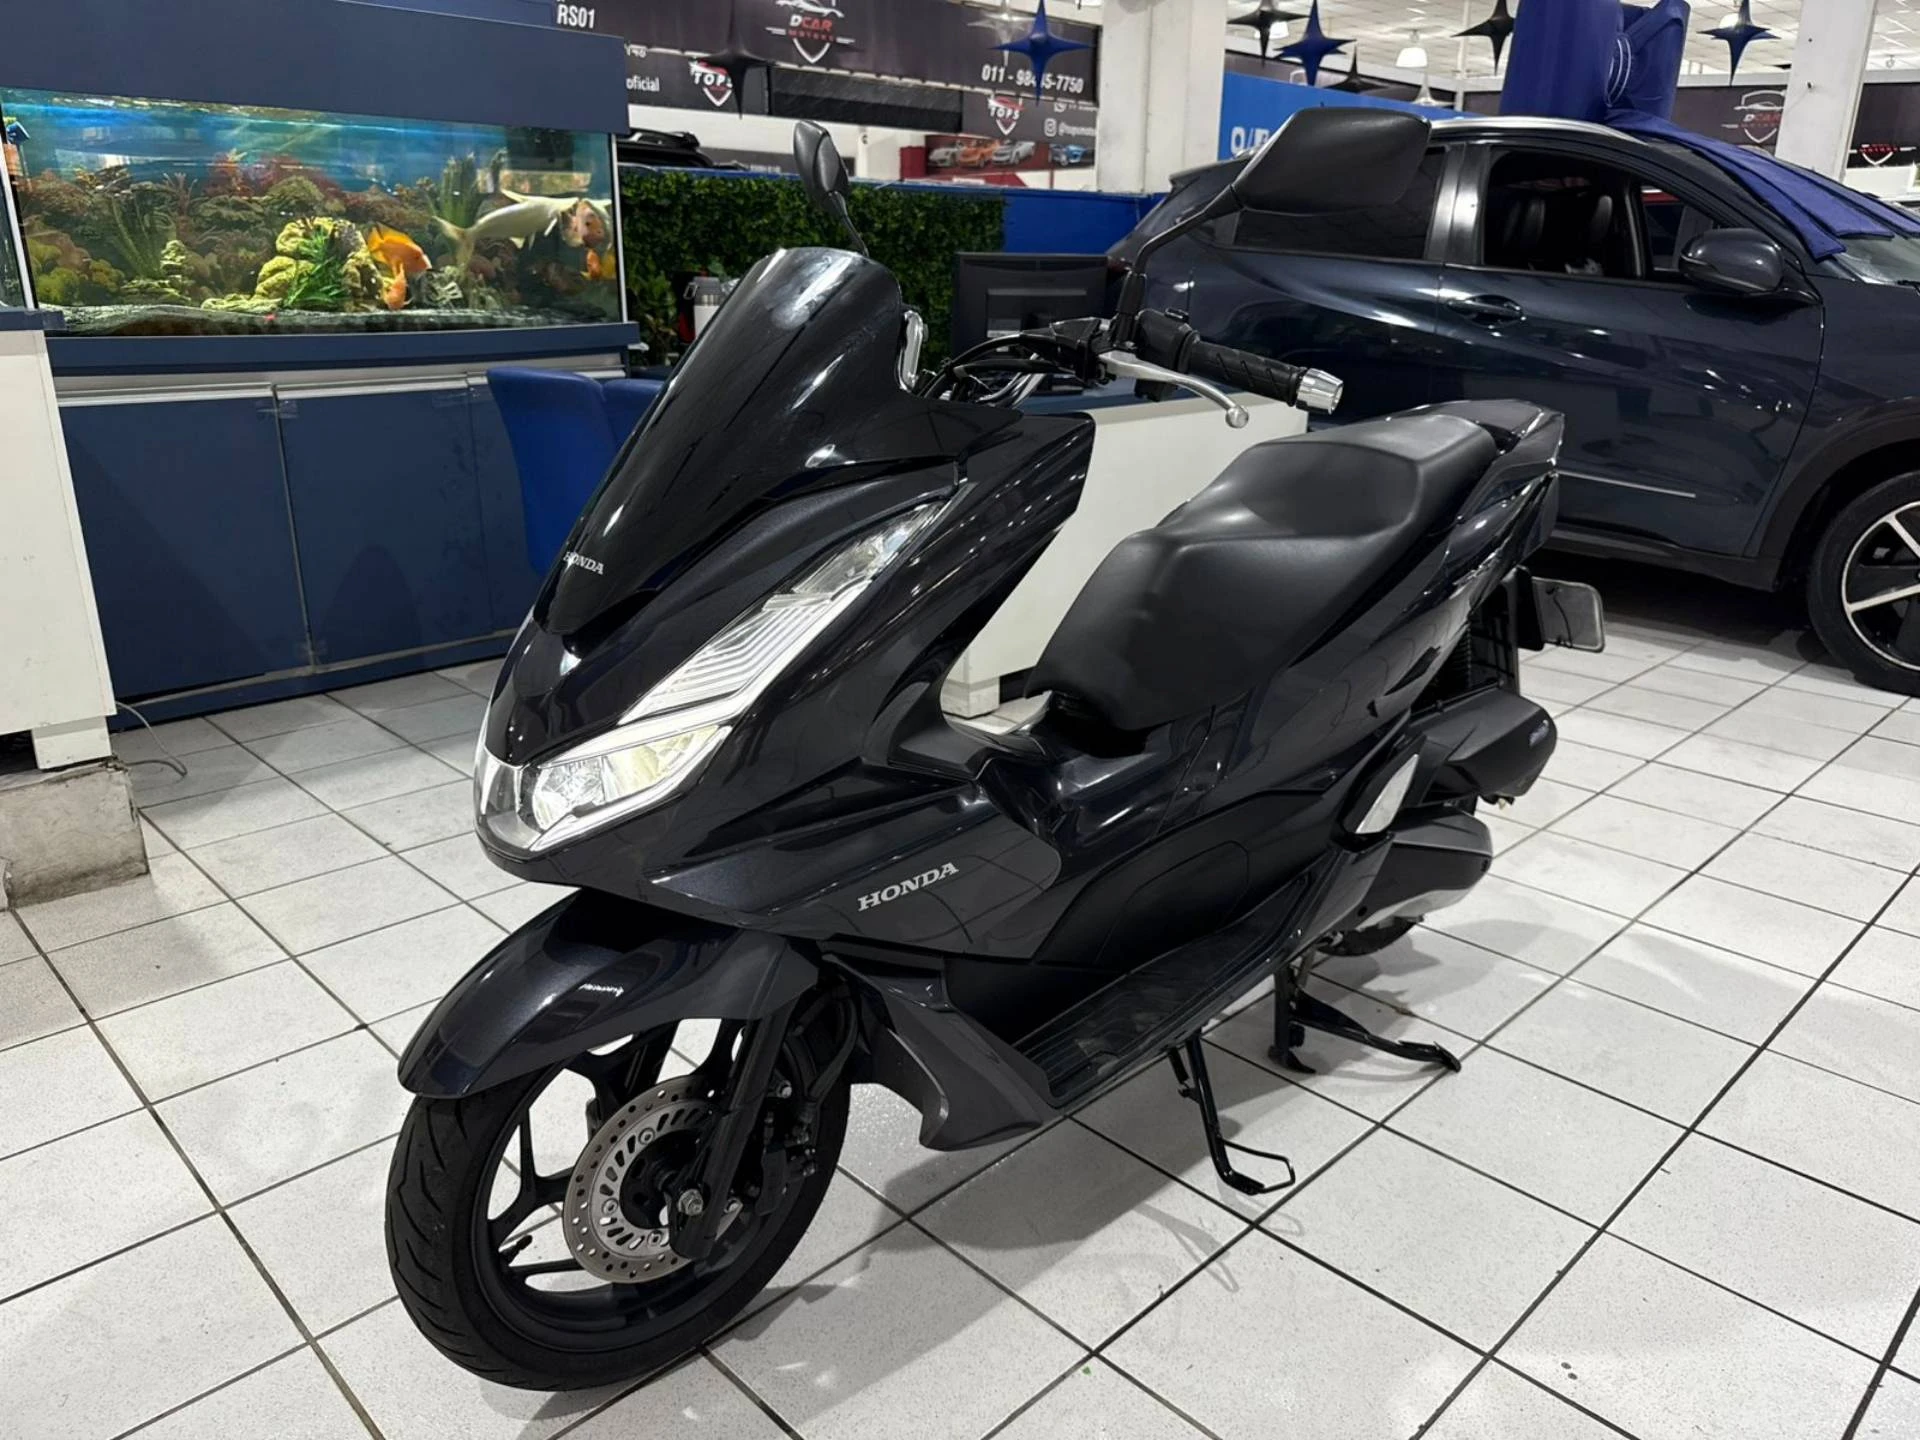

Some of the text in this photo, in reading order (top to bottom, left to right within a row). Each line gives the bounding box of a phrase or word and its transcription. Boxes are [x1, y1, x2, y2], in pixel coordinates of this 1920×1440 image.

[981, 64, 1006, 83] 011
[990, 106, 1020, 120] TOPS
[563, 551, 604, 575] HONDA
[858, 862, 960, 911] HONDA
